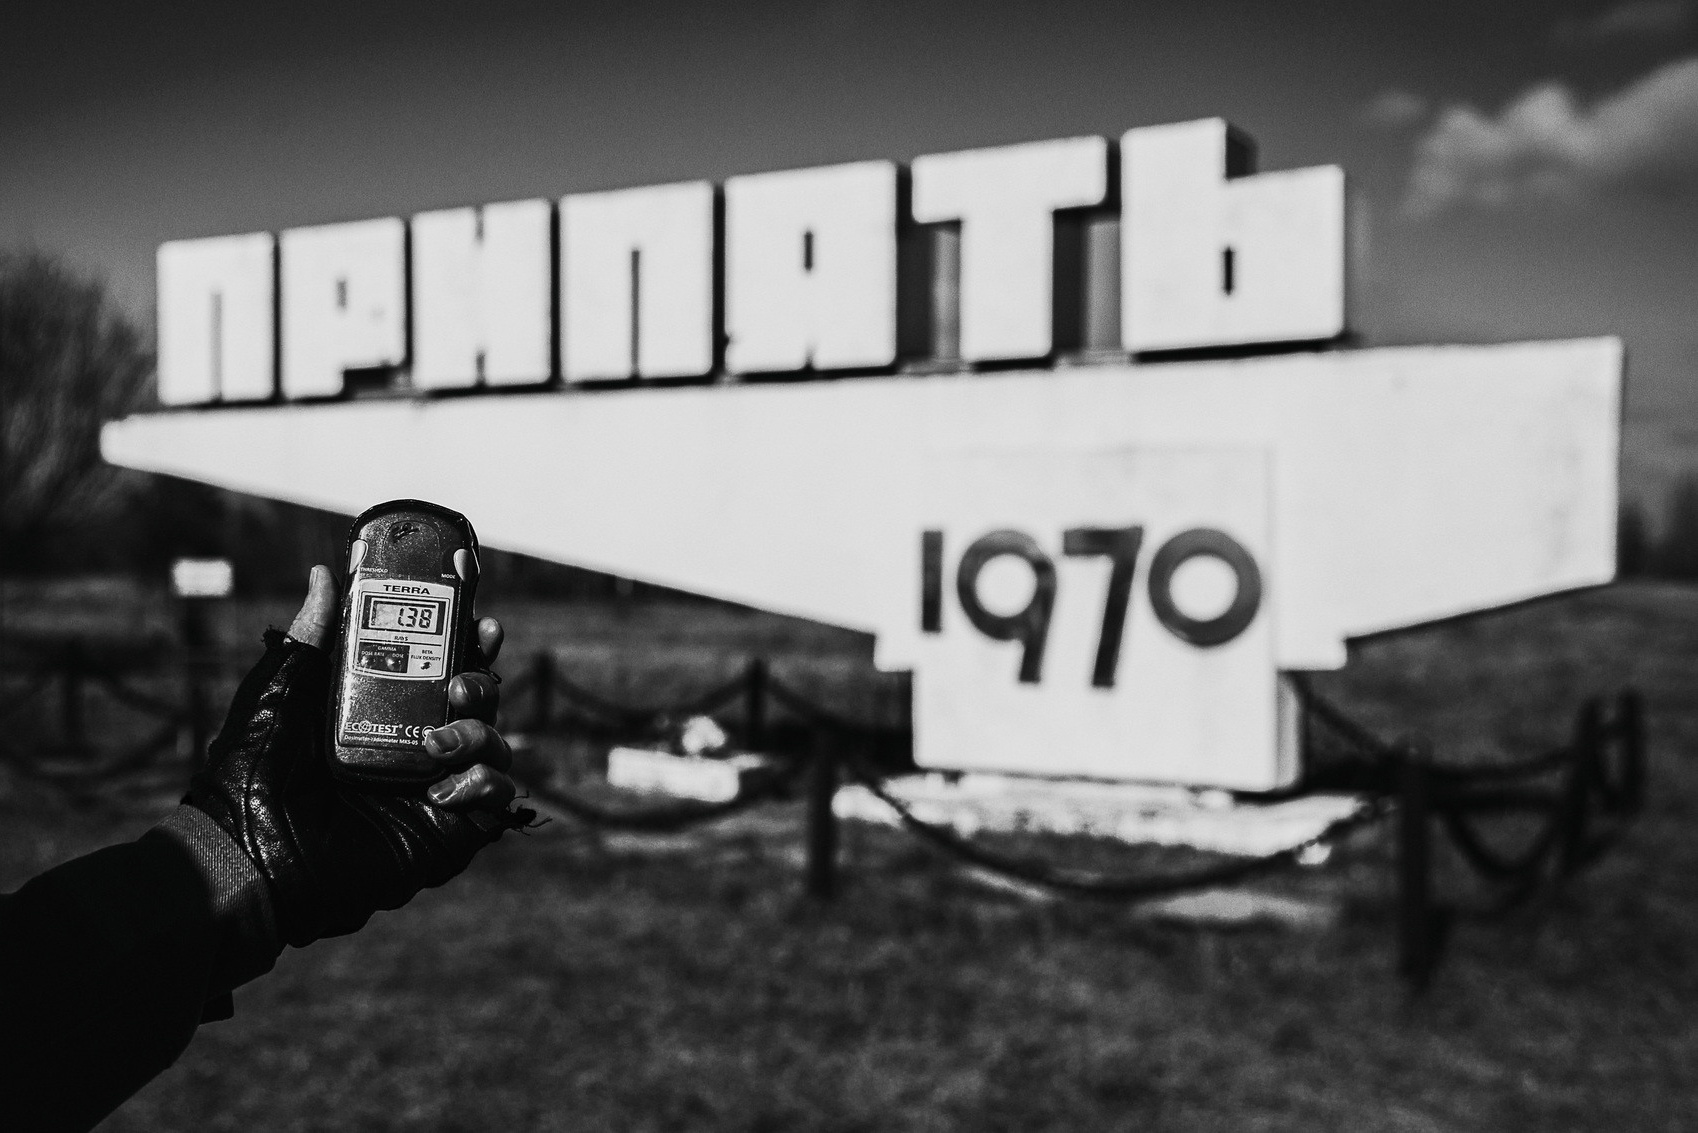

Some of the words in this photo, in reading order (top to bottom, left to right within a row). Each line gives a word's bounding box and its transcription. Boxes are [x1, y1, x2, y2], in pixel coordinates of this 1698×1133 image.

[157, 117, 1345, 406] ПРИПЯТЬ
[383, 584, 430, 595] TERRA
[921, 525, 1263, 688] 1970
[405, 725, 420, 738] CE
